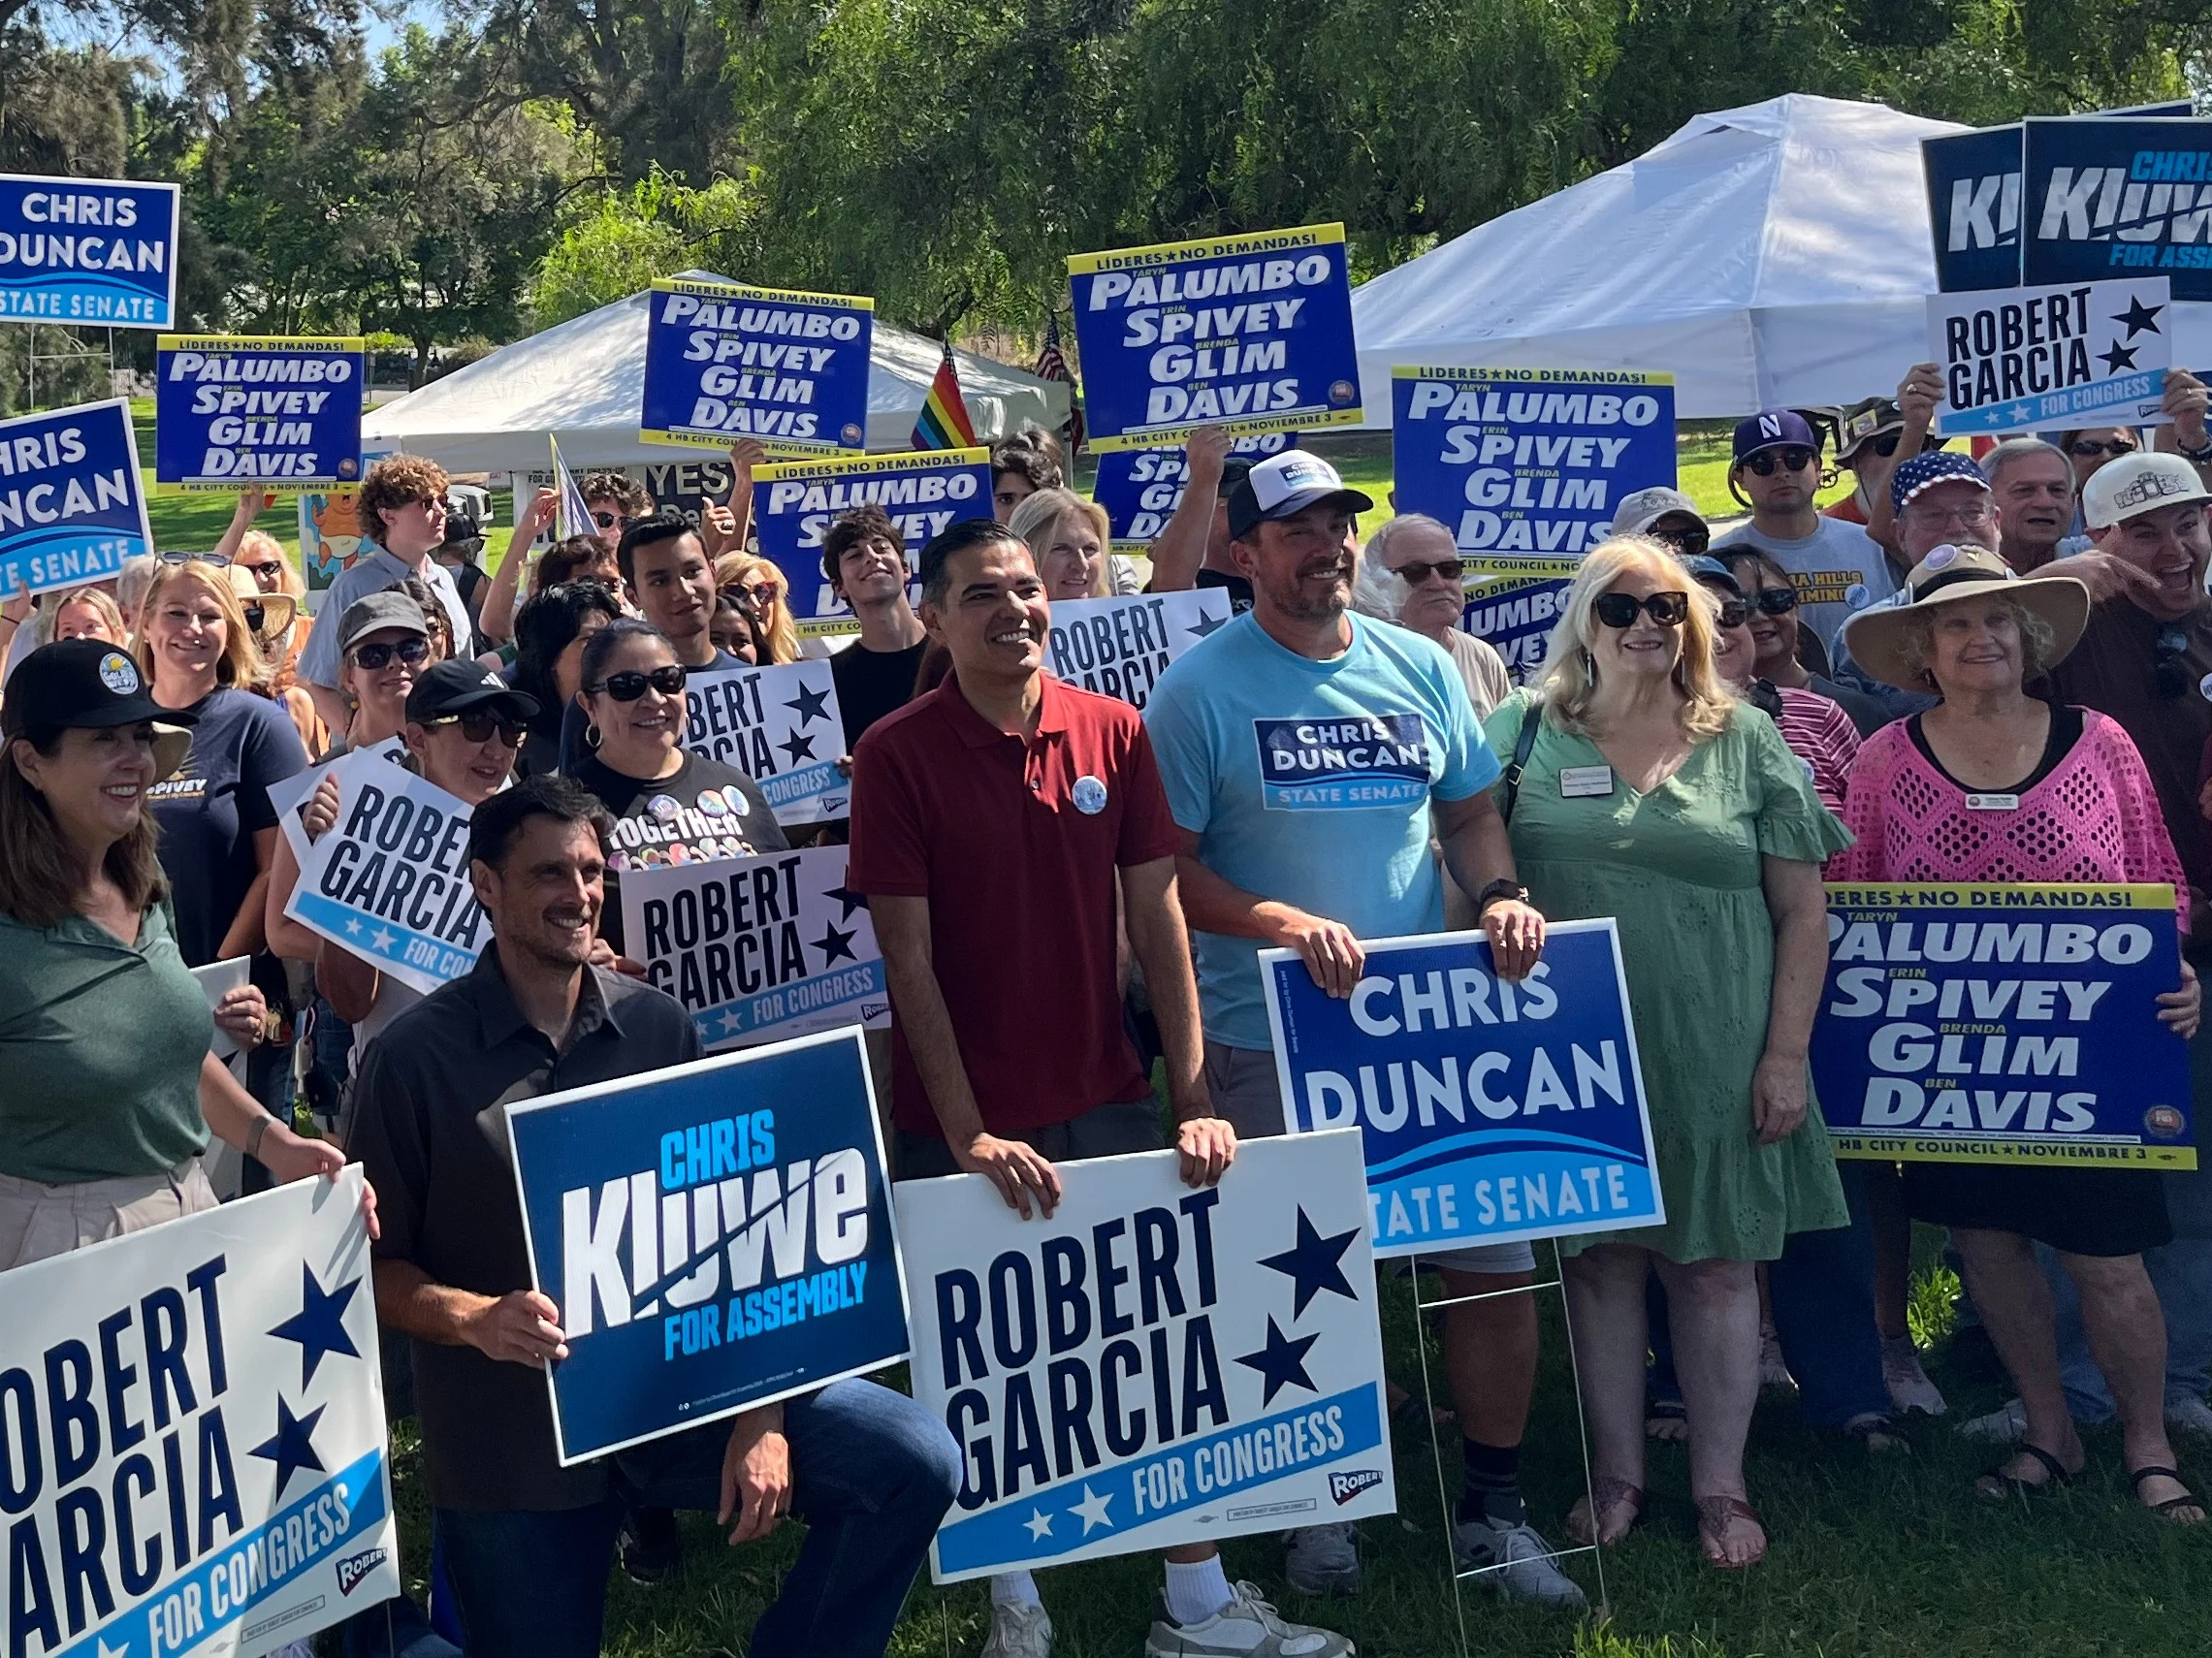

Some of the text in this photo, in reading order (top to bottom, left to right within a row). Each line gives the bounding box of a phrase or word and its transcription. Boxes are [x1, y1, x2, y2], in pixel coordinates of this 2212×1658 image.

[22, 192, 138, 228] CHRIS
[0, 232, 164, 273] DUNCAN
[1097, 234, 1317, 271] LÍDERES NO DEMANDAS!
[1133, 267, 1167, 277] TARYN
[2109, 243, 2157, 267] FOR
[673, 282, 853, 308] LÍDERES NO DEMANDAS!
[1088, 254, 1330, 312] PALUMBO
[0, 291, 155, 320] STATE SENATE
[661, 294, 860, 340] PALUMBO
[1122, 297, 1306, 348] SPIVEY
[1946, 287, 2092, 364] ROBERT
[179, 339, 344, 351] LÍDERES NO DEMANDAS!
[683, 331, 836, 372] SPIVEY
[1148, 340, 1286, 383] GLIM
[1195, 337, 1239, 349] BRENDA
[169, 352, 352, 383] PALUMBO
[700, 366, 815, 404] GLIM
[1187, 381, 1208, 391] BEN
[1420, 366, 1647, 384] LÍDERES NO DEMANDAS!
[1456, 383, 1491, 392] TARYN
[1948, 337, 2092, 410] GARCIA
[191, 384, 331, 415] SPIVEY
[1146, 378, 1299, 425] DAVIS
[1408, 381, 1659, 427] PALUMBO
[2040, 375, 2150, 417] FOR CONGRESS
[208, 415, 312, 446] GLIM
[689, 397, 818, 438] DAVIS
[1132, 435, 1148, 444] HB
[1152, 431, 1178, 442] CITY
[1248, 416, 1320, 430] NOVIEMBRE
[1325, 413, 1331, 422] 3
[1482, 427, 1508, 435] ERIN
[1758, 414, 1781, 439] N
[0, 428, 86, 476] HRIS
[201, 447, 318, 476] DAVIS
[692, 435, 713, 444] CITY
[771, 443, 830, 456] NOVIEMBRE
[1440, 425, 1631, 468] SPIVEY
[647, 462, 729, 496] YES
[775, 454, 966, 479] LÍDERES NO DEMANDAS!
[1514, 468, 1559, 478] BRENDA
[0, 468, 129, 532] NCAN
[768, 472, 978, 515] PALUMBO
[1464, 467, 1607, 510] GLIM
[1457, 509, 1612, 553] DAVIS
[1501, 511, 1523, 520] BEN
[30, 539, 129, 584] SENATE
[1461, 559, 1549, 570] CITY COUNCIL
[1812, 570, 1863, 586] HILLS
[1465, 589, 1485, 602] NO
[820, 622, 843, 632] CITY
[1049, 598, 1170, 678] ROBERT
[687, 672, 765, 744] BERT
[1296, 721, 1391, 745] CHRIS
[1272, 743, 1422, 771] DUNCAN
[761, 766, 831, 805] CONGRESS
[1278, 782, 1422, 803] STATE SENATE
[343, 783, 470, 883] ROBE
[320, 840, 486, 949] GARCIA
[643, 856, 802, 960] ROBERT
[1825, 890, 2132, 907] ERES NO DEMANDAS!
[1845, 911, 1899, 922] TARYN
[403, 938, 436, 971] FOR
[648, 920, 808, 1012] GARCIA
[1888, 968, 1927, 977] ERIN
[753, 967, 874, 1025] FOR CONGRESS
[1349, 961, 1559, 1037] CHRIS
[1830, 967, 2112, 1022] SPIVEY
[1868, 1022, 2079, 1077] GLIM
[1940, 1023, 2006, 1035] BRENDA
[1305, 1039, 1625, 1132] DUNCAN
[1861, 1076, 2098, 1132] DAVIS
[1924, 1078, 1957, 1089] BEN
[660, 1108, 775, 1191] CHRIS
[1839, 1139, 2147, 1160] HB CITY COUNCIL NOVIEMBRE 3
[1368, 1164, 1629, 1239] TATE SENATE
[935, 1188, 1220, 1390] ROBERT
[665, 1260, 868, 1360] FOR ASSEMBLY
[0, 1253, 228, 1515] OBERT
[946, 1314, 1230, 1512] GARCIA
[1133, 1405, 1345, 1516] FOR CONGRESS
[1332, 1470, 1384, 1499] ROBERT
[9, 1404, 244, 1658] ARCIA
[148, 1482, 351, 1658] FOR CONGRESS
[339, 1547, 388, 1590] ROBERT
